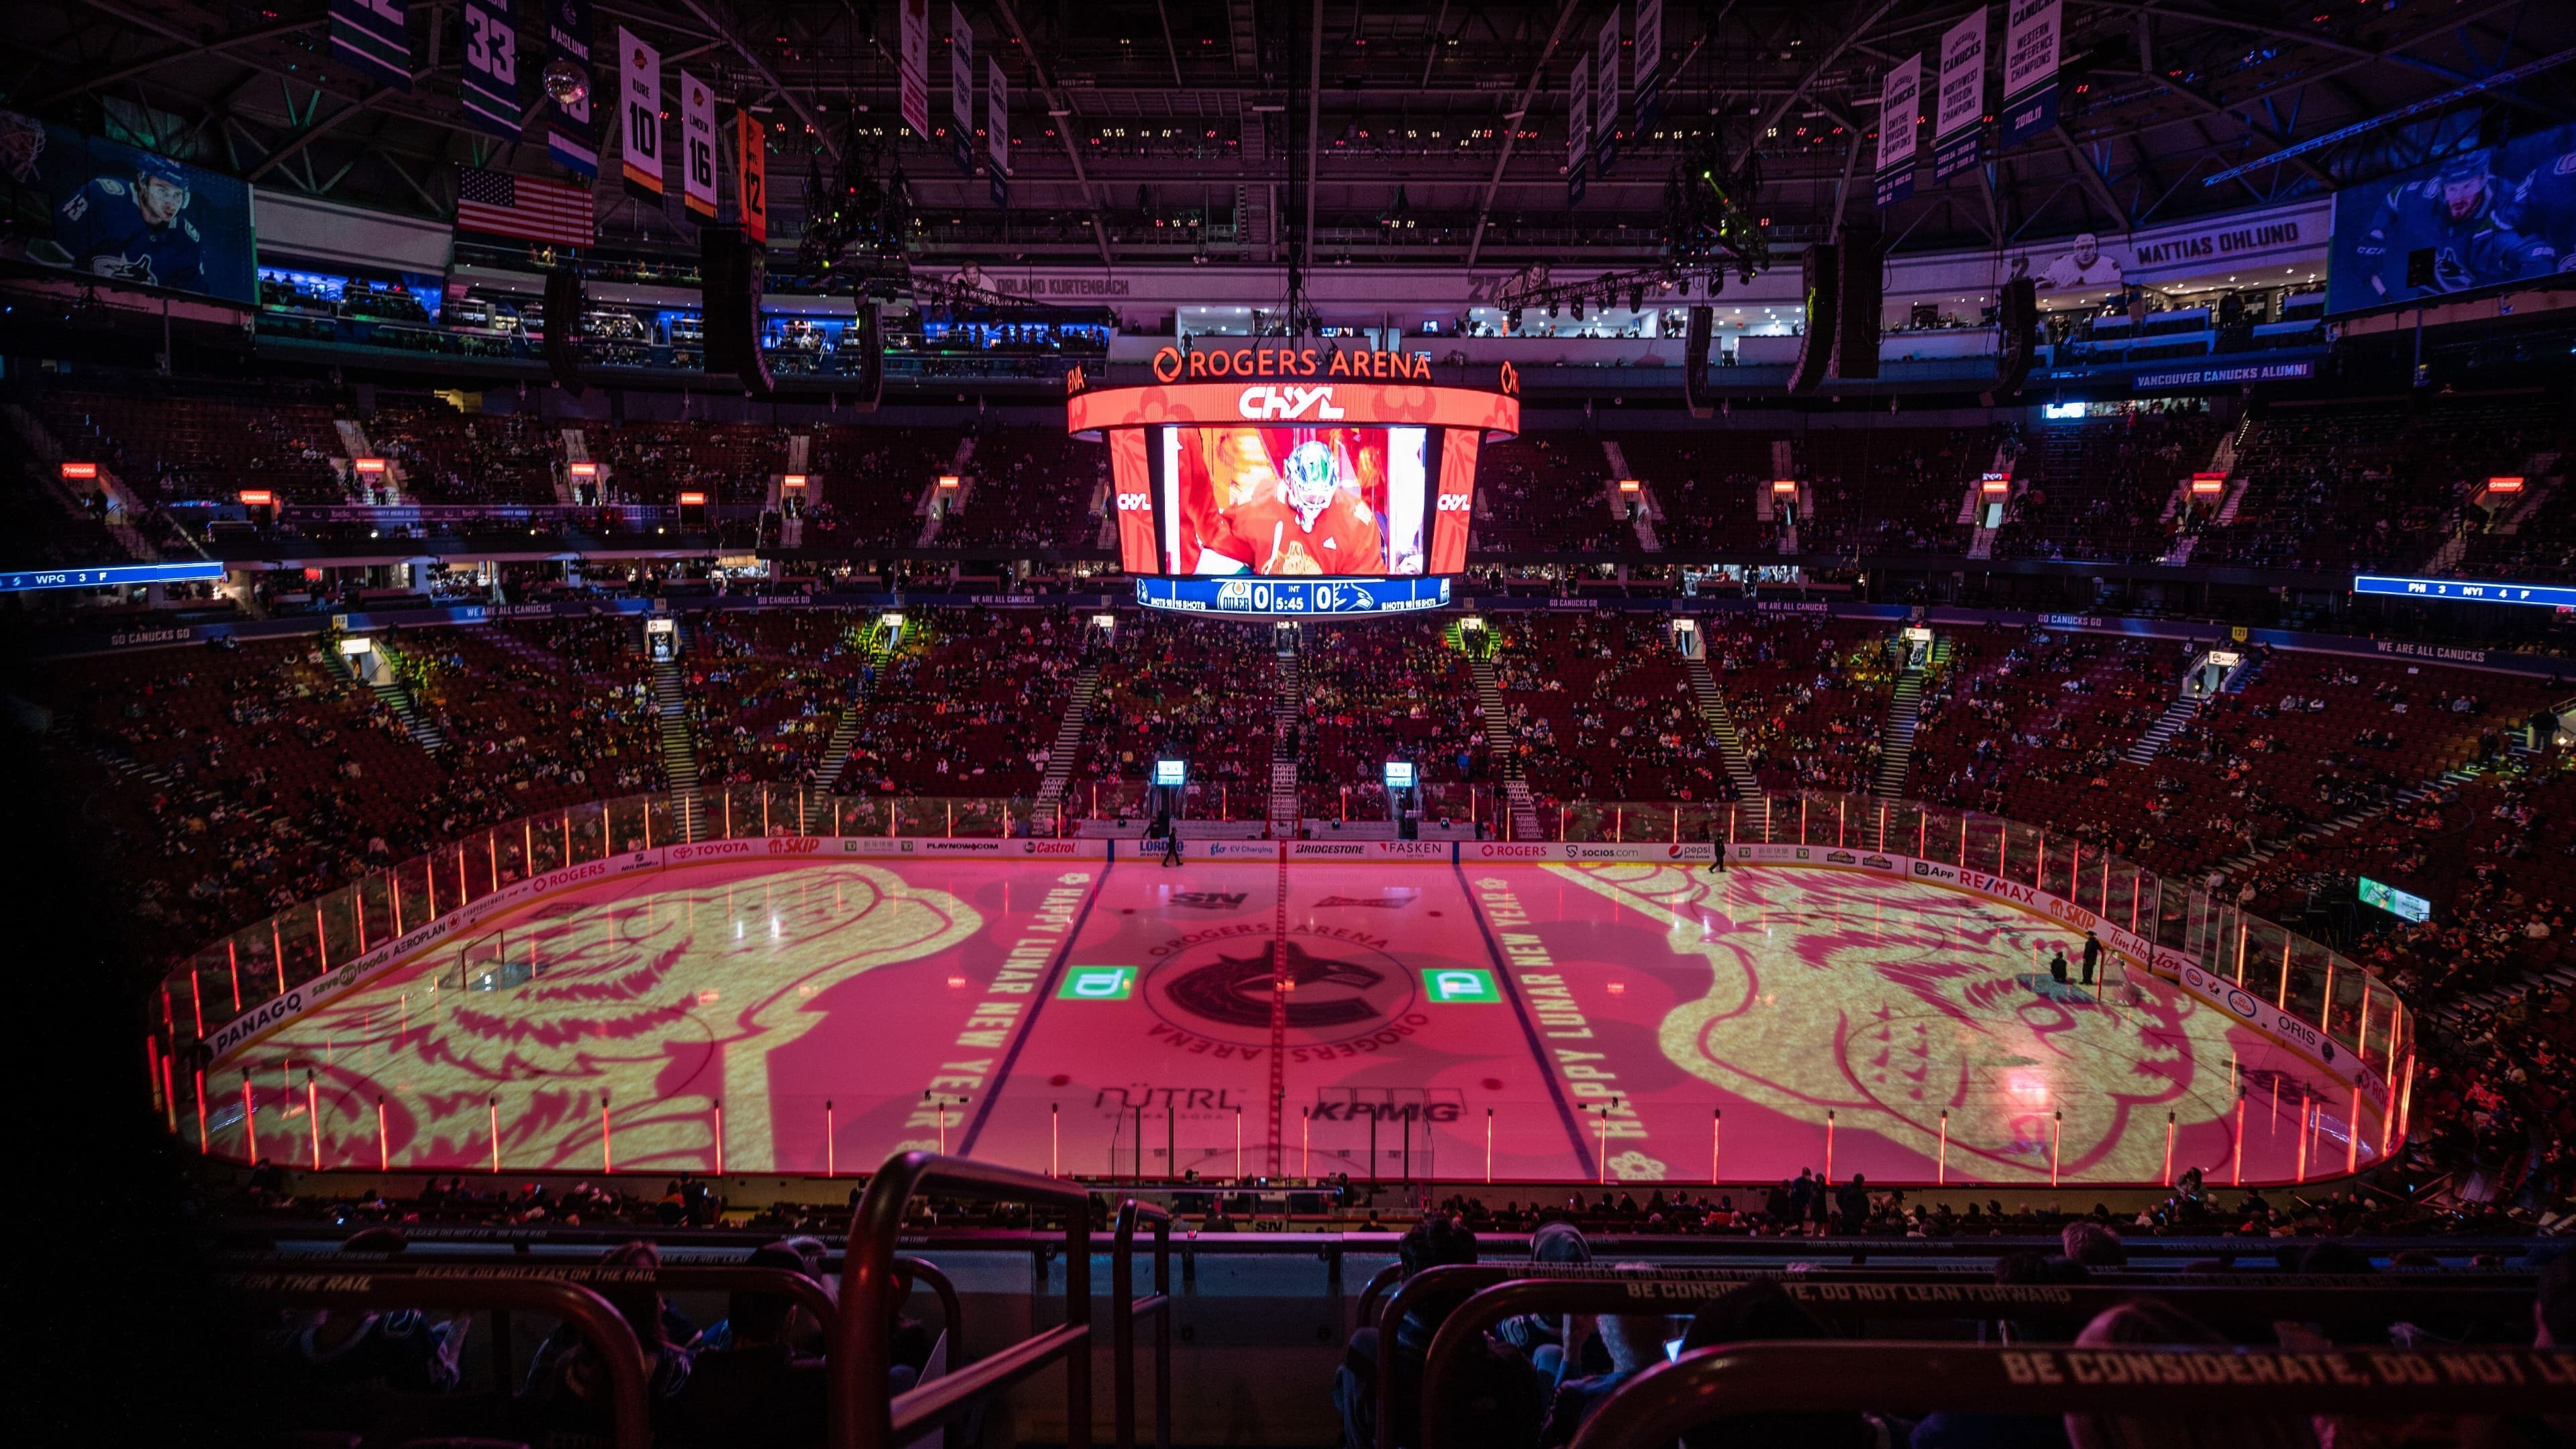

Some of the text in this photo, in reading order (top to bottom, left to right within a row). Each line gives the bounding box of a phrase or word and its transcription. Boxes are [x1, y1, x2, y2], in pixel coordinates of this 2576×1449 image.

[466, 3, 516, 86] 33
[2017, 21, 2049, 50] WESTERN
[1944, 40, 1981, 74] CANUCKS
[2010, 34, 2053, 68] CONFERENCE
[2011, 50, 2051, 83] CHAMPIONS
[633, 78, 650, 99] BURE
[1944, 68, 1977, 97] NORTHWEST
[1884, 84, 1916, 113] CANUCKS
[1947, 86, 1972, 108] DIVISION
[1943, 97, 1976, 123] CHAMPIONS
[2014, 105, 2042, 130] 2010.11
[630, 101, 656, 159] 10
[690, 136, 712, 189] 16
[744, 169, 763, 215] 12
[2136, 222, 2298, 264] MATTIAS OHLUND
[996, 279, 1129, 295] ORLAND KURTENBACH
[1190, 349, 1432, 379] ROGERS ARENA
[2137, 364, 2308, 387] VANCOUVER CANUCKS ALUMNI
[36, 574, 66, 584] WPG
[79, 573, 86, 582] 3
[99, 572, 107, 581] F
[1288, 585, 1300, 593] INT
[769, 596, 799, 604] CANUCKS
[1253, 585, 1269, 609] 0
[1316, 586, 1331, 609] 0
[2408, 583, 2426, 593] PHI
[2438, 585, 2446, 594] 3
[2463, 587, 2483, 596] NYI
[2499, 589, 2508, 598] 4
[467, 604, 552, 617] WE ARE ALL CANUCKS
[1276, 597, 1304, 610] 5:45
[1589, 599, 1597, 607] GO
[1769, 602, 1782, 610] ARE
[1784, 602, 1794, 610] ALL
[1797, 603, 1828, 611] CANUCKS
[2038, 614, 2102, 627] GO CANUCKS GO
[111, 628, 191, 645] GO CANUCKS GO
[2378, 641, 2485, 662] WE ARE ALL CANUCKS
[697, 843, 748, 855] TOYOTA
[784, 839, 819, 852] SKIP
[1037, 842, 1075, 852] Castrol
[1140, 841, 1184, 852] LORDO
[1210, 842, 1226, 855] flo
[1296, 844, 1365, 854] BRIDGESTONE
[1390, 843, 1441, 853] FASKEN
[1497, 846, 1547, 856] ROGERS
[1582, 848, 1638, 857] socios.com
[1685, 846, 1710, 855] pepsi
[550, 863, 605, 886] ROGERS
[1959, 870, 2034, 905] RE/MAX
[1482, 893, 1531, 928] YEAR
[2063, 904, 2096, 930] SKIP
[393, 923, 446, 957] AEROPLAN
[1172, 923, 1389, 949] ROGERS ARENA
[2110, 927, 2129, 951] Tim
[1500, 932, 1554, 966] NEW
[1075, 969, 1124, 995] TD
[1437, 971, 1484, 999] TD
[905, 888, 1084, 1128] HAPPY LUNAR NEW YEAR
[1521, 973, 1594, 1039] LUNAR
[2231, 998, 2252, 1012] CANADA
[217, 993, 301, 1054] PANAGO
[2279, 1015, 2316, 1046] ORIS
[1148, 1022, 1416, 1062] ROGERS ARENA
[1555, 1048, 1649, 1139] HAPPY
[1310, 1101, 1460, 1122] KPMG
[1255, 1222, 1283, 1231] SN
[281, 1276, 321, 1289] THE
[324, 1275, 372, 1291] RAIL
[497, 1268, 524, 1278] NOT
[529, 1268, 567, 1279] LEAN
[570, 1268, 592, 1281] ON
[595, 1269, 621, 1281] THE
[625, 1269, 656, 1282] RAIL
[1638, 1270, 1655, 1279] DO
[1659, 1270, 1690, 1280] NOT
[1695, 1270, 1731, 1281] LEAN
[1626, 1283, 2073, 1302] BE DO NOT LEAN FORWARD
[2001, 1352, 2526, 1389] BE CONSIDERATE, DO NOT
